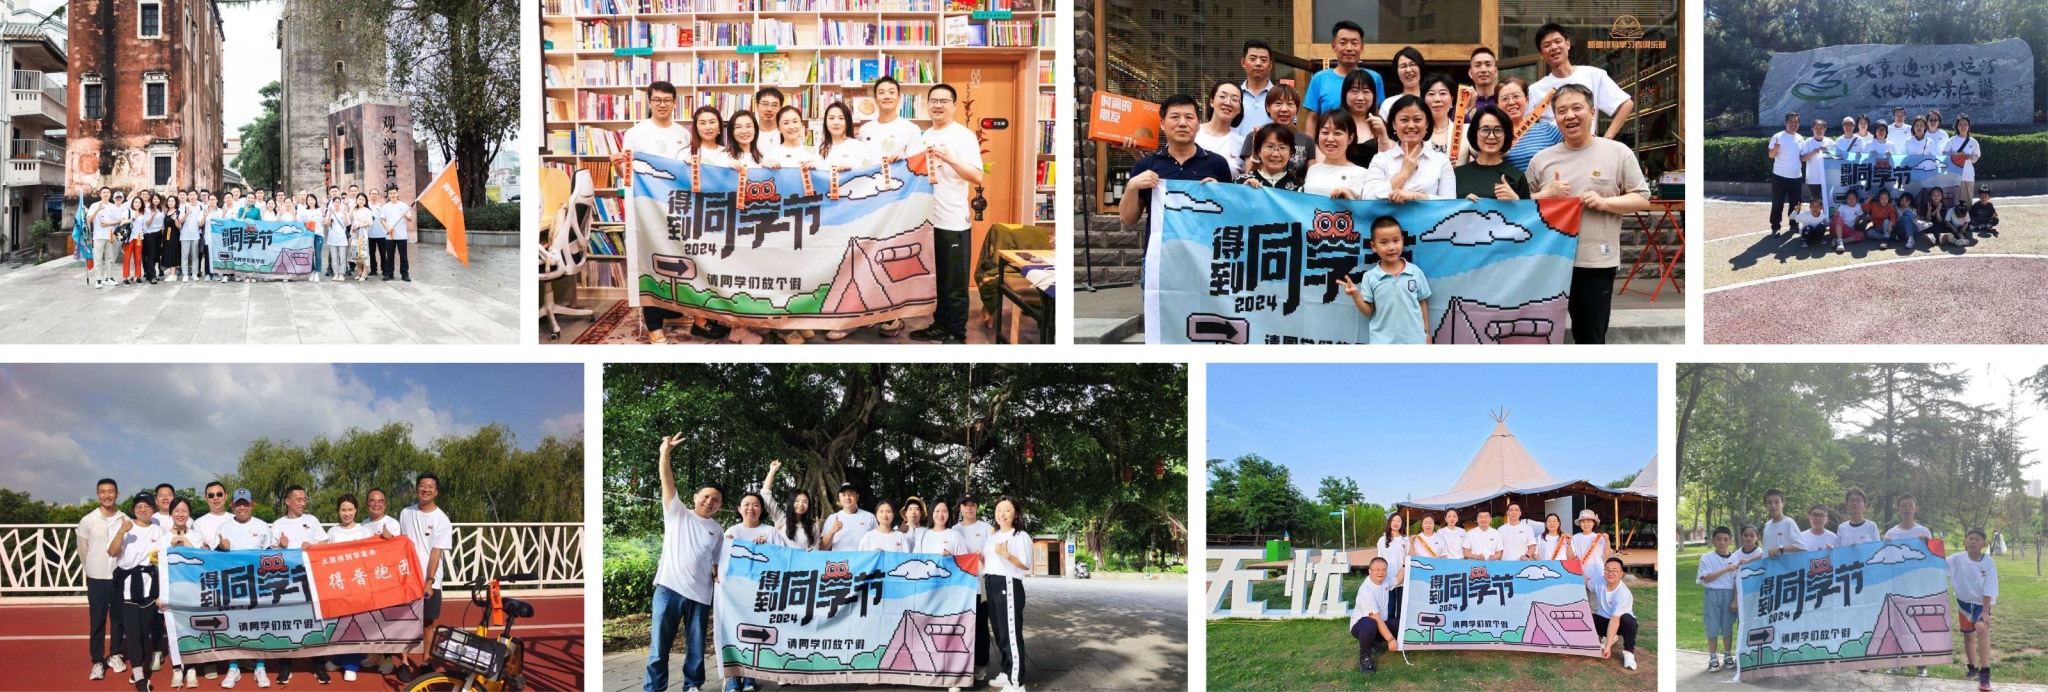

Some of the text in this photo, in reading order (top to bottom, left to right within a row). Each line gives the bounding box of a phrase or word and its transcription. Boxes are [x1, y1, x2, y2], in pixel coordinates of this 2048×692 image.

[1101, 94, 1132, 113] 时间的
[1099, 108, 1121, 124] 朋友
[1853, 163, 1912, 192] 同学节
[667, 189, 823, 259] 得到 同学节
[230, 227, 273, 252] 同学节
[685, 243, 717, 256] 2024
[1210, 225, 1244, 296] 得到
[707, 274, 801, 290] 请同学们放个假
[1234, 295, 1278, 313] 2024
[329, 559, 410, 590] 得晋跑团
[1206, 549, 1351, 614] 无忧
[200, 571, 221, 608] 得到
[754, 569, 886, 626] 得到 同学节
[1429, 572, 1514, 612] 得到 同学节
[1758, 560, 1864, 621] 得到 同学节
[1439, 603, 1458, 612] 2024
[1768, 610, 1791, 624] 2024
[238, 620, 313, 632] 请同学们放个假
[769, 613, 798, 624] 2024
[787, 638, 865, 650] 请同学们放个假
[1781, 627, 1851, 644] 请同学们放个假
